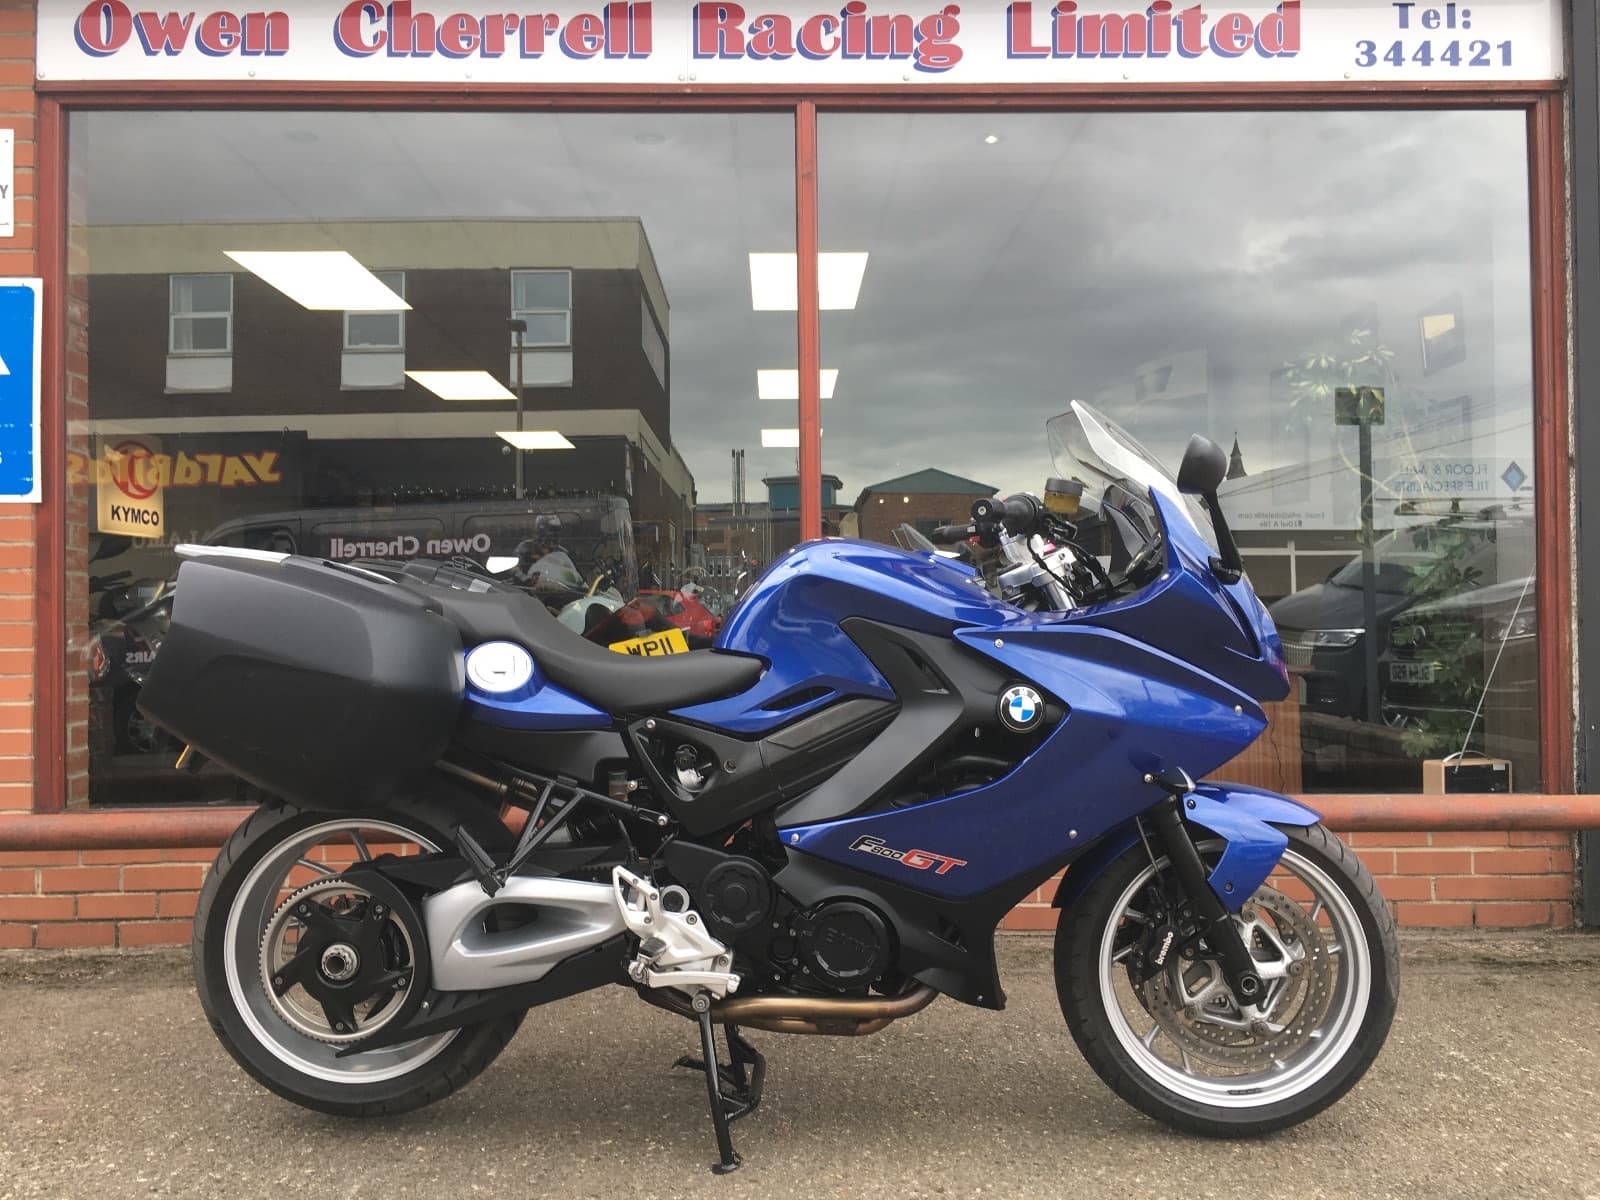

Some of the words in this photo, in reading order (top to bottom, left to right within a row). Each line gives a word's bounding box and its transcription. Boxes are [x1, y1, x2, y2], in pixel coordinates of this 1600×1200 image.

[1391, 2, 1472, 30] Tel:
[74, 0, 290, 57] Owen
[333, 0, 652, 59] Cherrell
[693, 0, 964, 74] Racing
[1006, 0, 1301, 60] Limited
[1354, 39, 1513, 68] 344421
[110, 505, 160, 526] KYMCO
[1154, 931, 1174, 966] brembo
